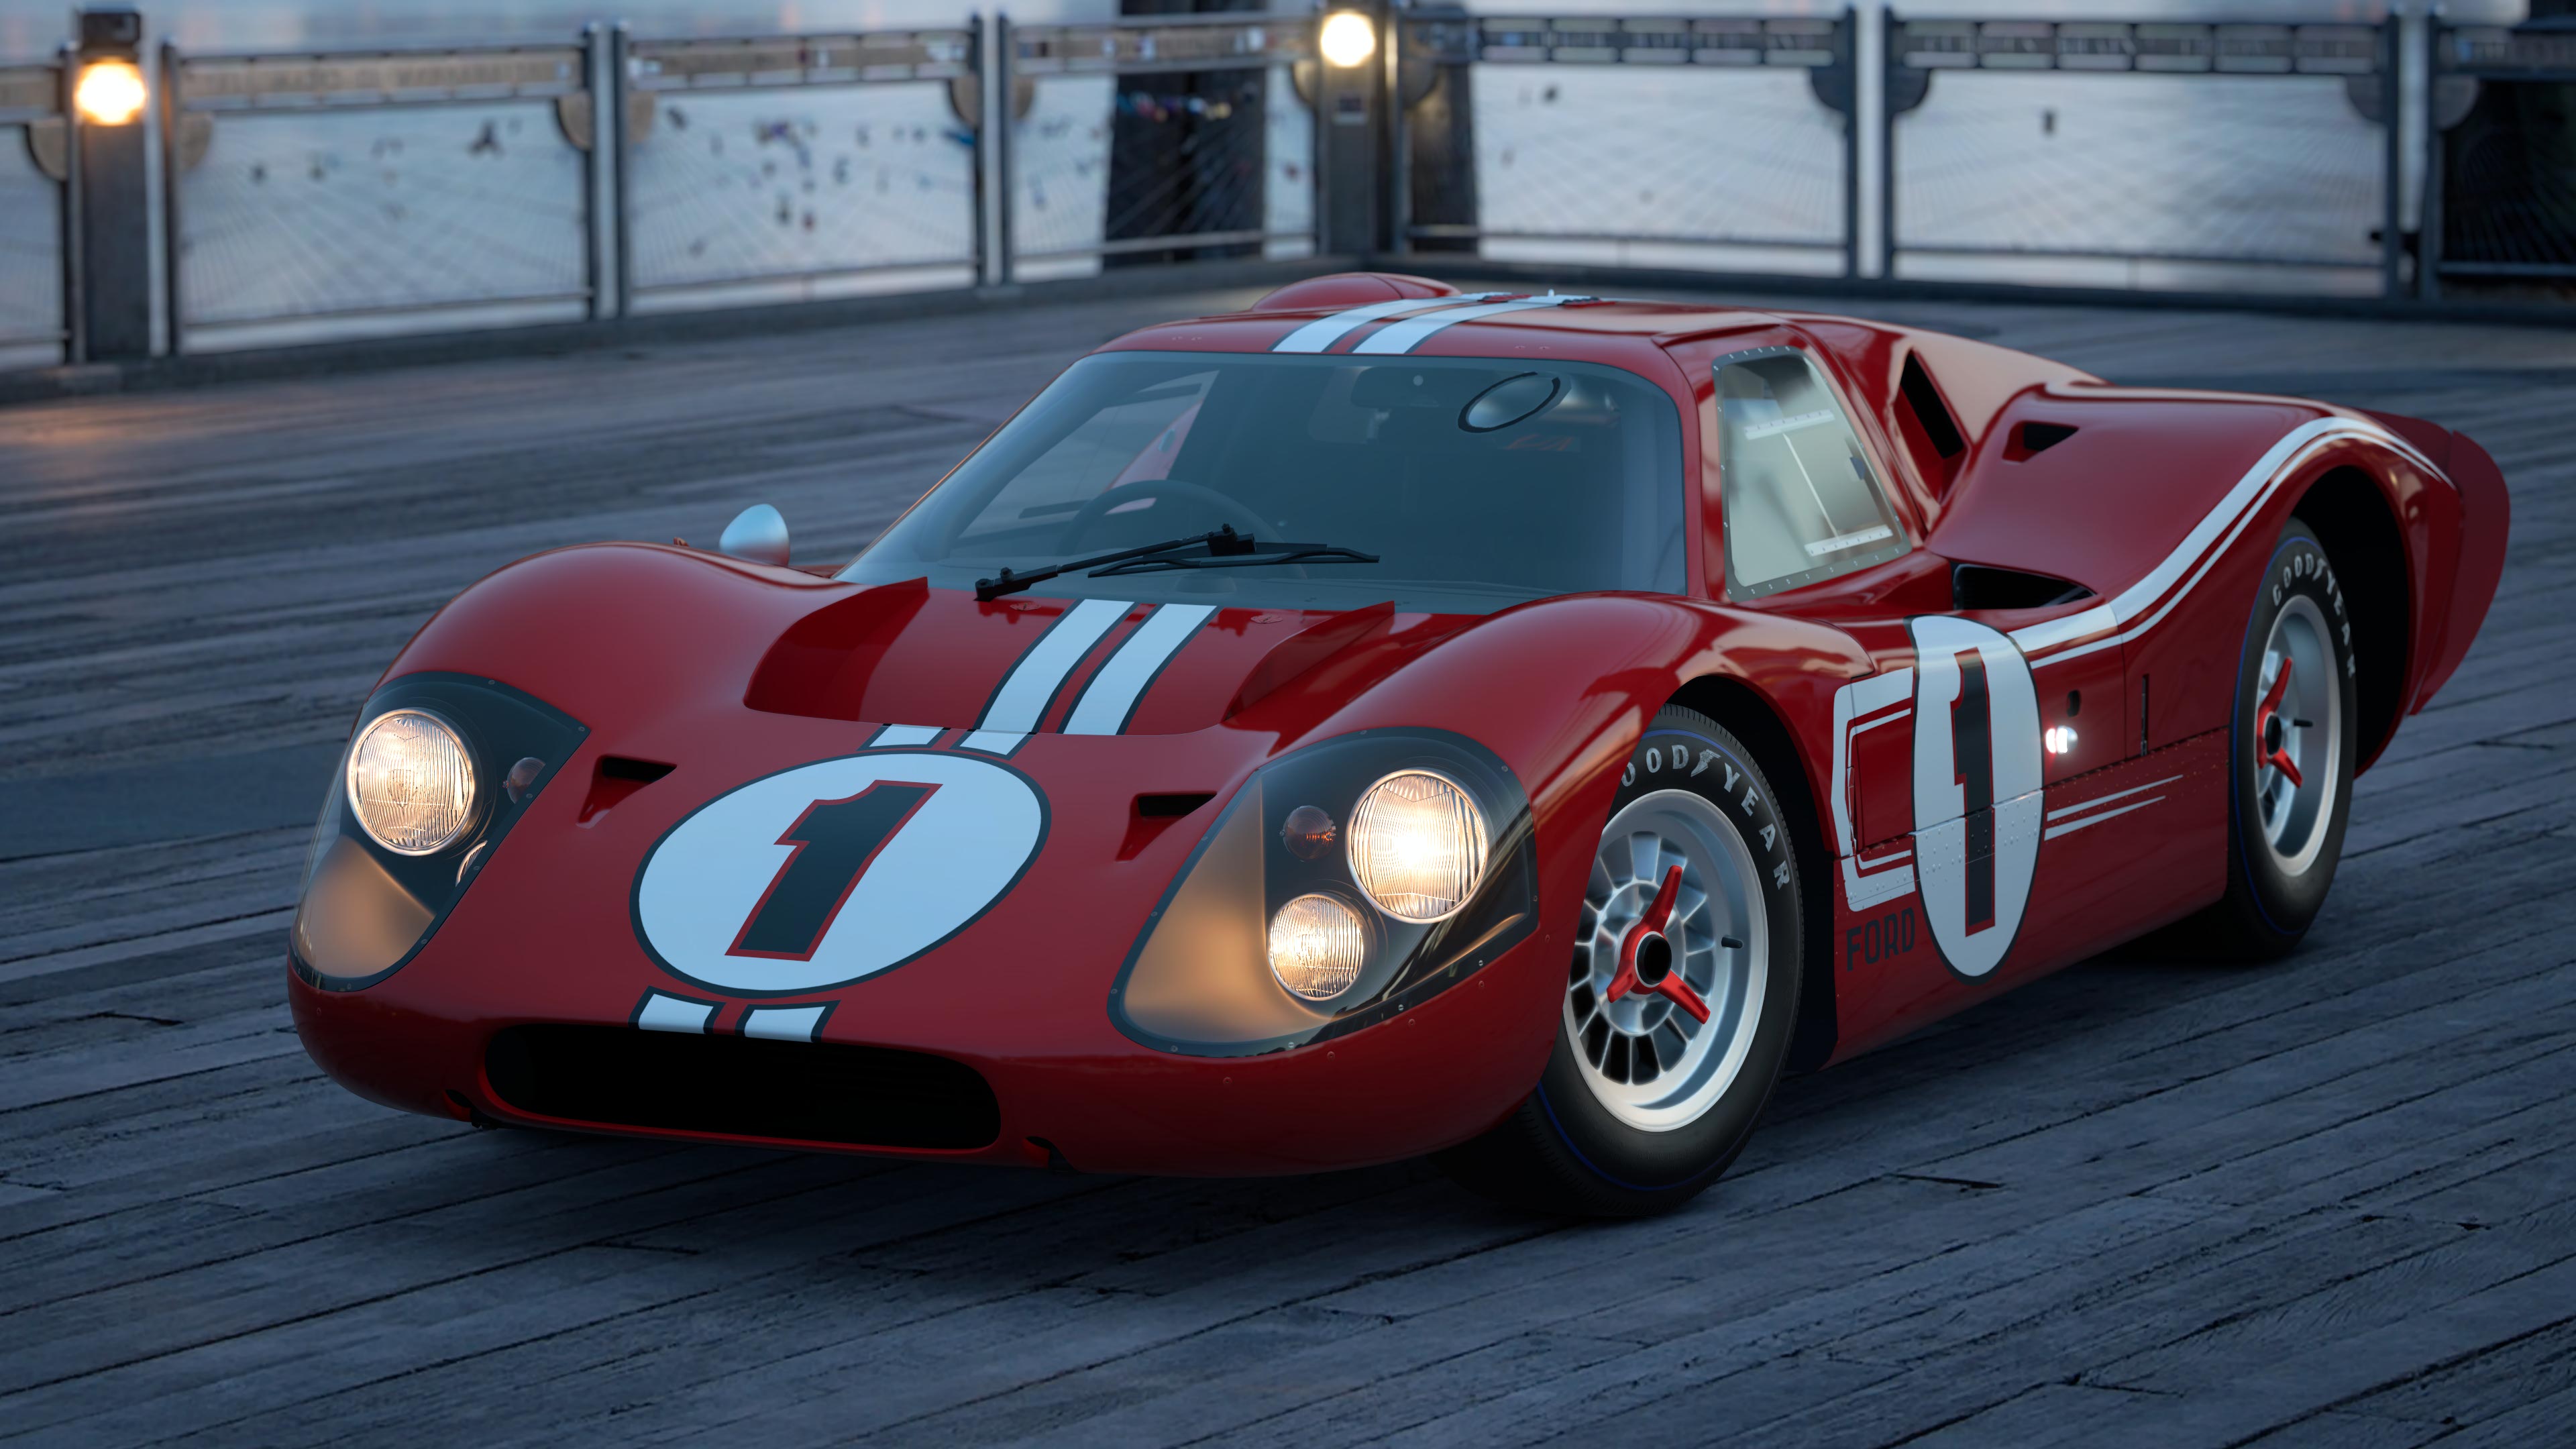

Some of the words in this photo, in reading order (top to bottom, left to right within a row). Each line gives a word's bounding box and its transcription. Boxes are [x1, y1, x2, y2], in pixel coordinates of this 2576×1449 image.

[2271, 552, 2357, 678] GOODYEAR
[1621, 744, 1790, 890] OODYEAR
[1950, 646, 1996, 938] 1
[724, 779, 944, 962] 1
[1846, 907, 1916, 972] FORD
